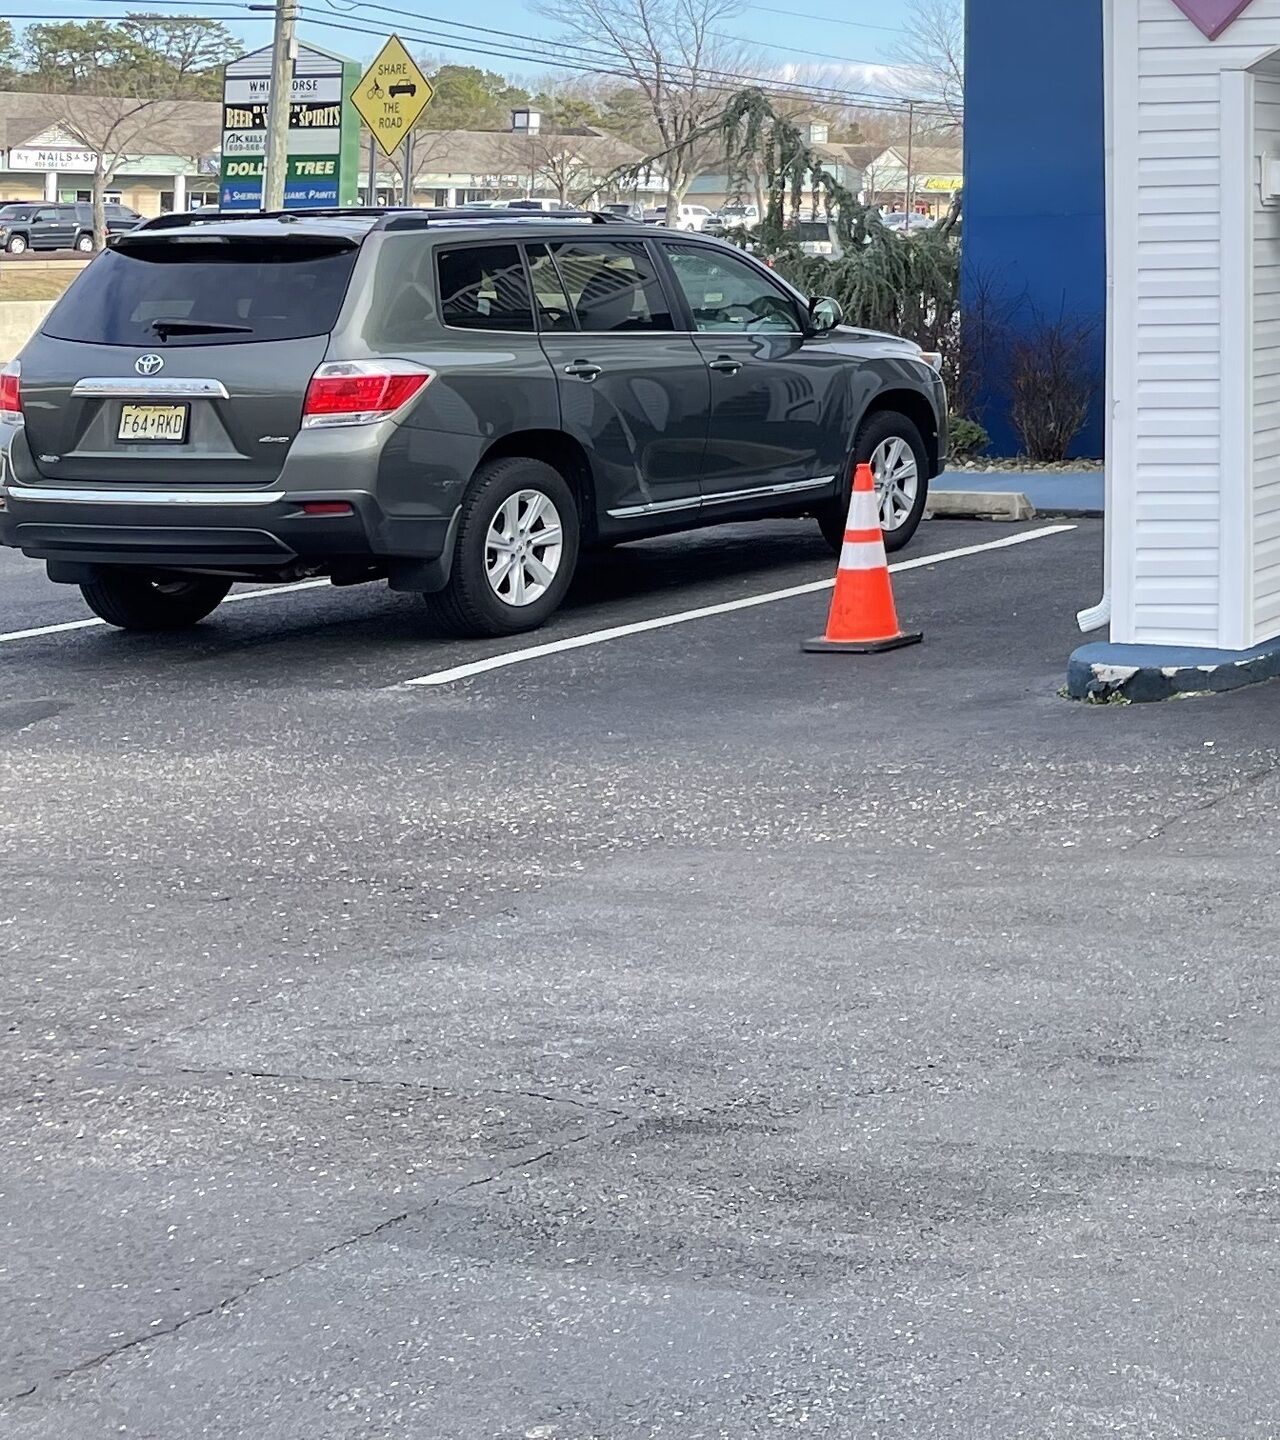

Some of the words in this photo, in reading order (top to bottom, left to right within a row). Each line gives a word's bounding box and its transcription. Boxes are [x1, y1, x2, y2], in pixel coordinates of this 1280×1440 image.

[378, 63, 407, 76] SHARE
[249, 80, 269, 92] WHI
[292, 79, 319, 91] ORSE
[383, 102, 399, 114] THE
[225, 107, 253, 128] BEER
[298, 105, 340, 126] SPIRITS
[379, 117, 402, 129] ROAD
[38, 151, 73, 162] NAILS
[83, 153, 97, 162] SP
[295, 161, 336, 175] TREE
[308, 189, 337, 200] PAINTS
